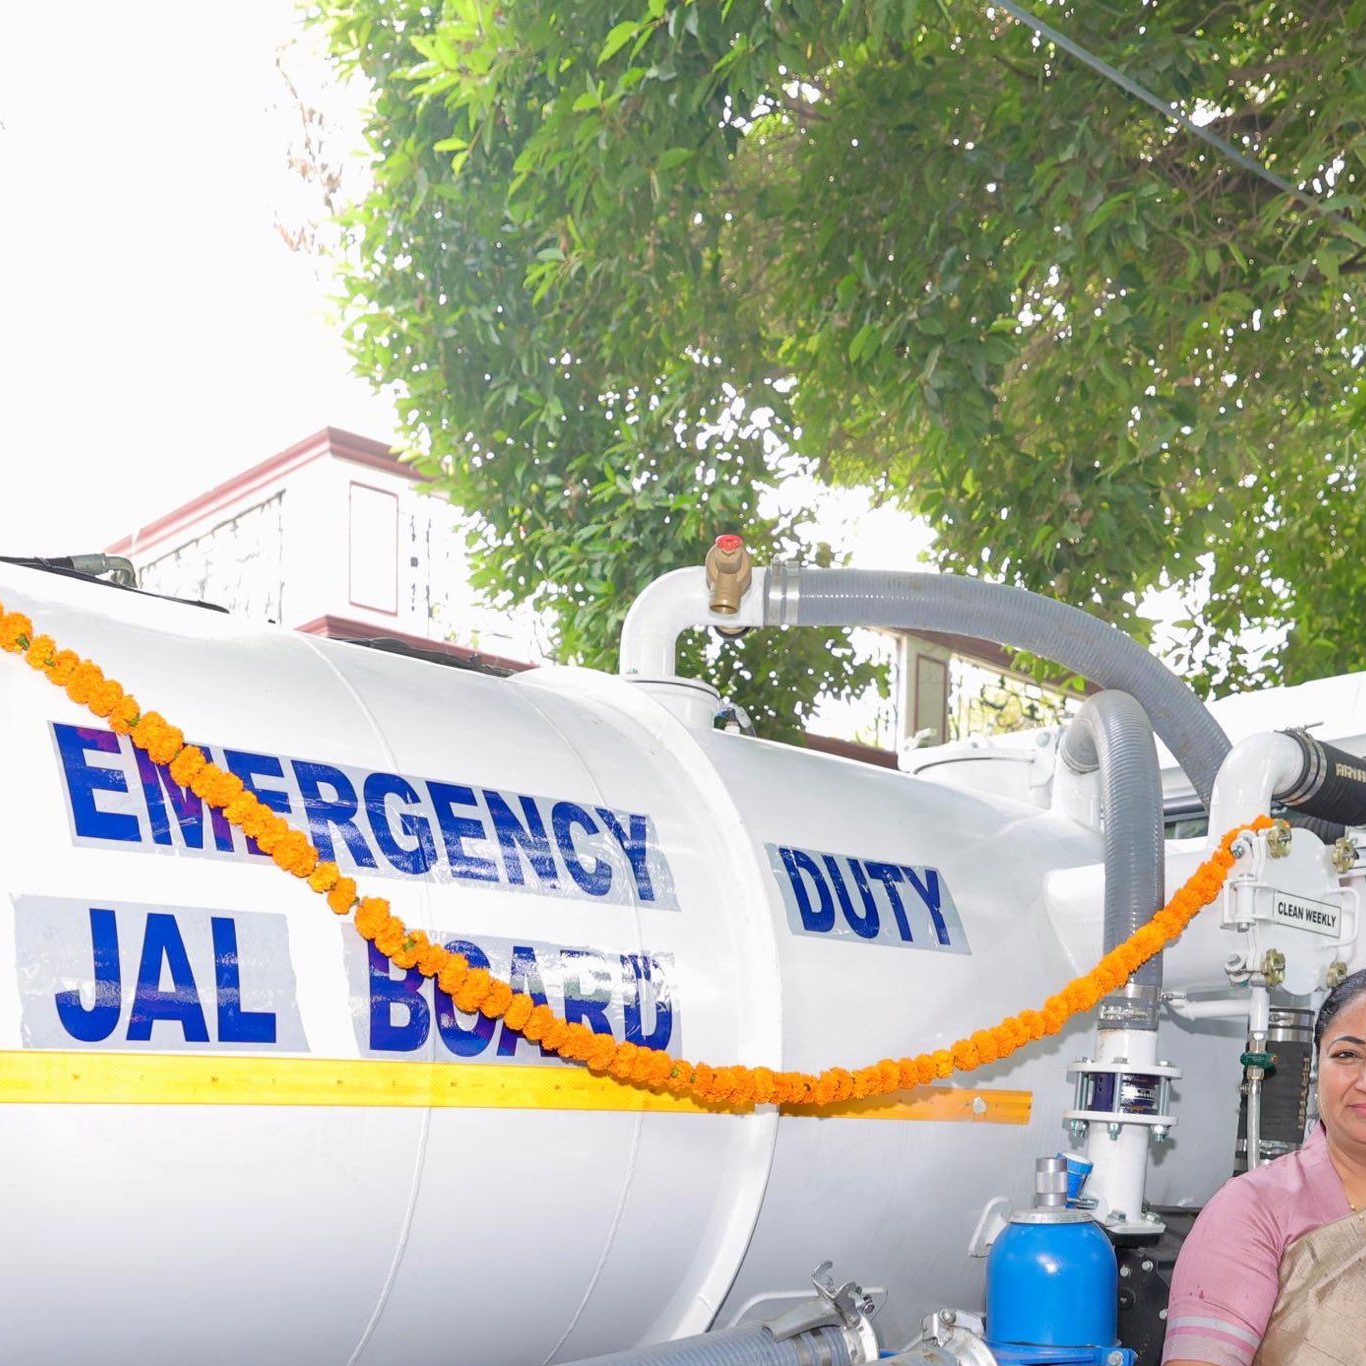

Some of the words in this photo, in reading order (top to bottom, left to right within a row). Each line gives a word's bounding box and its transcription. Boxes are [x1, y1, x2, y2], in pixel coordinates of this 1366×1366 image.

[53, 722, 656, 902] EMERGENCY
[779, 846, 951, 946] DUTY
[55, 908, 278, 1044] JAL
[368, 939, 673, 1057] BOARD
[1278, 902, 1304, 920] CLEAN
[1305, 908, 1337, 928] WEEKLY
